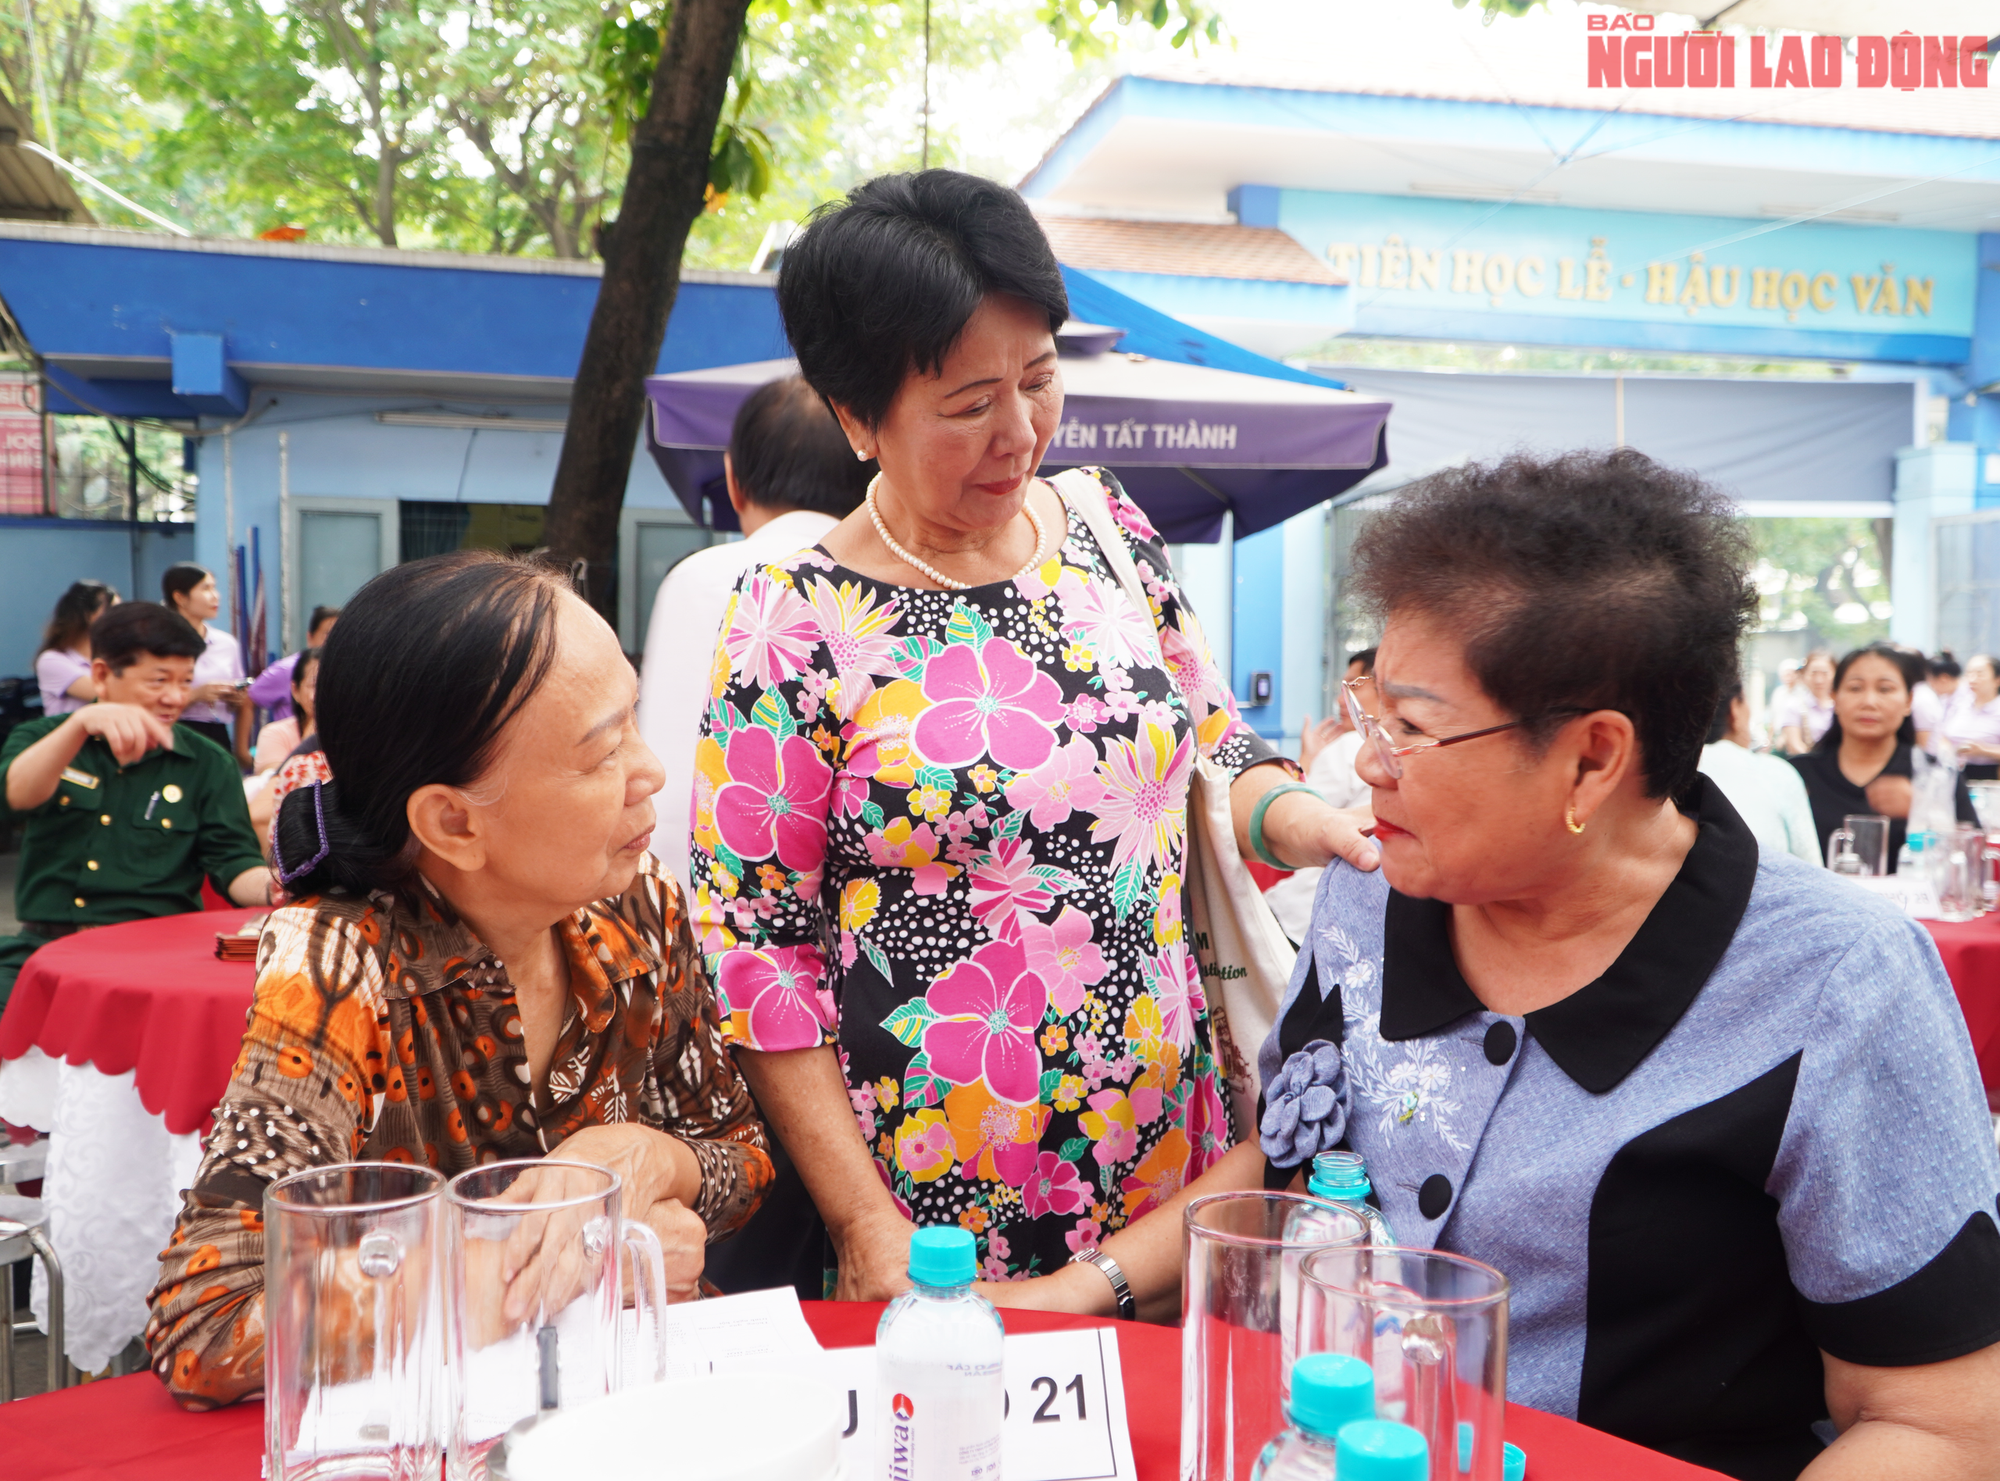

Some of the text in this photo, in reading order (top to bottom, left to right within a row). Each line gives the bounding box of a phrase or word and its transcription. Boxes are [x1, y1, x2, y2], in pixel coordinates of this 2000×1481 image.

[1450, 249, 1547, 307] HỌC
[1556, 236, 1613, 302] LỄ
[1645, 250, 1741, 316] HẬU
[1750, 267, 1838, 323] HỌC
[1850, 260, 1935, 317] VĂN
[1101, 416, 1149, 449] TẤT
[1151, 417, 1238, 450] THÀNH
[1030, 1374, 1087, 1424] 21
